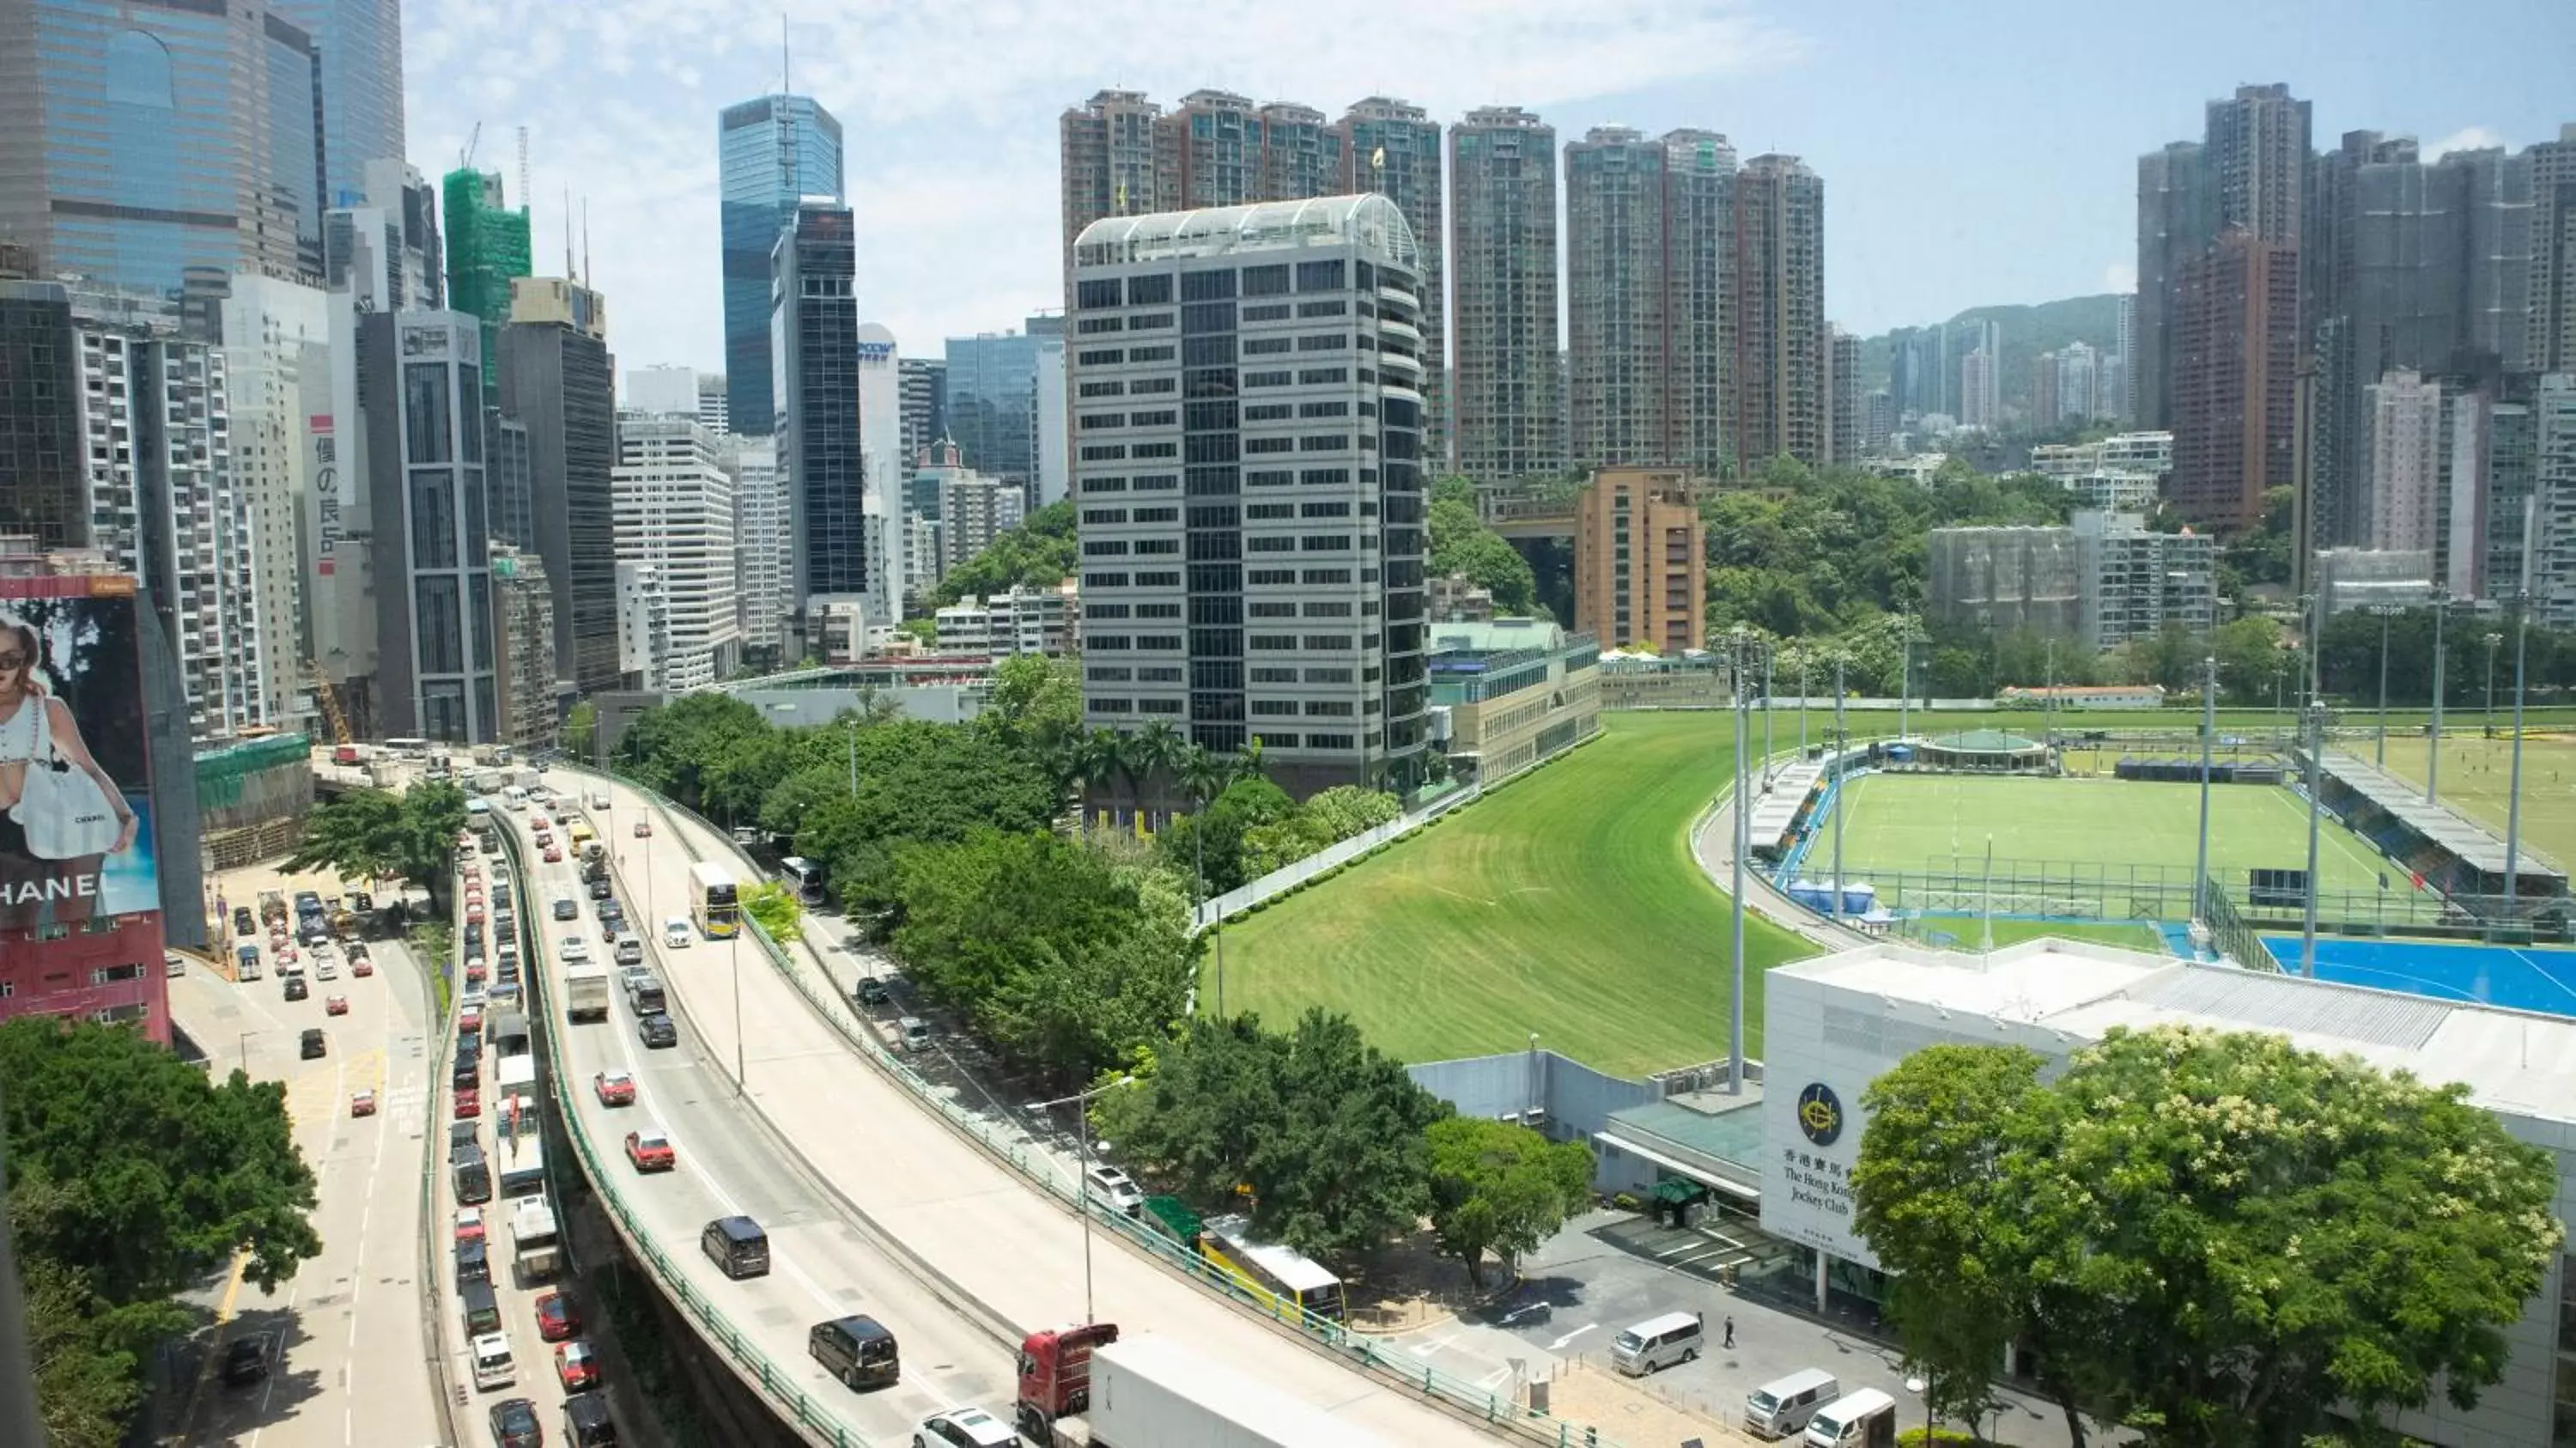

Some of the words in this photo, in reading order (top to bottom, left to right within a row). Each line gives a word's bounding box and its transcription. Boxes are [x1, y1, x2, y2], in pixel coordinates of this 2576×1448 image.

[1784, 1166, 1802, 1182] The
[1804, 1172, 1829, 1195] Hong
[1791, 1186, 1822, 1210] Jockey
[1825, 1197, 1849, 1215] Club
